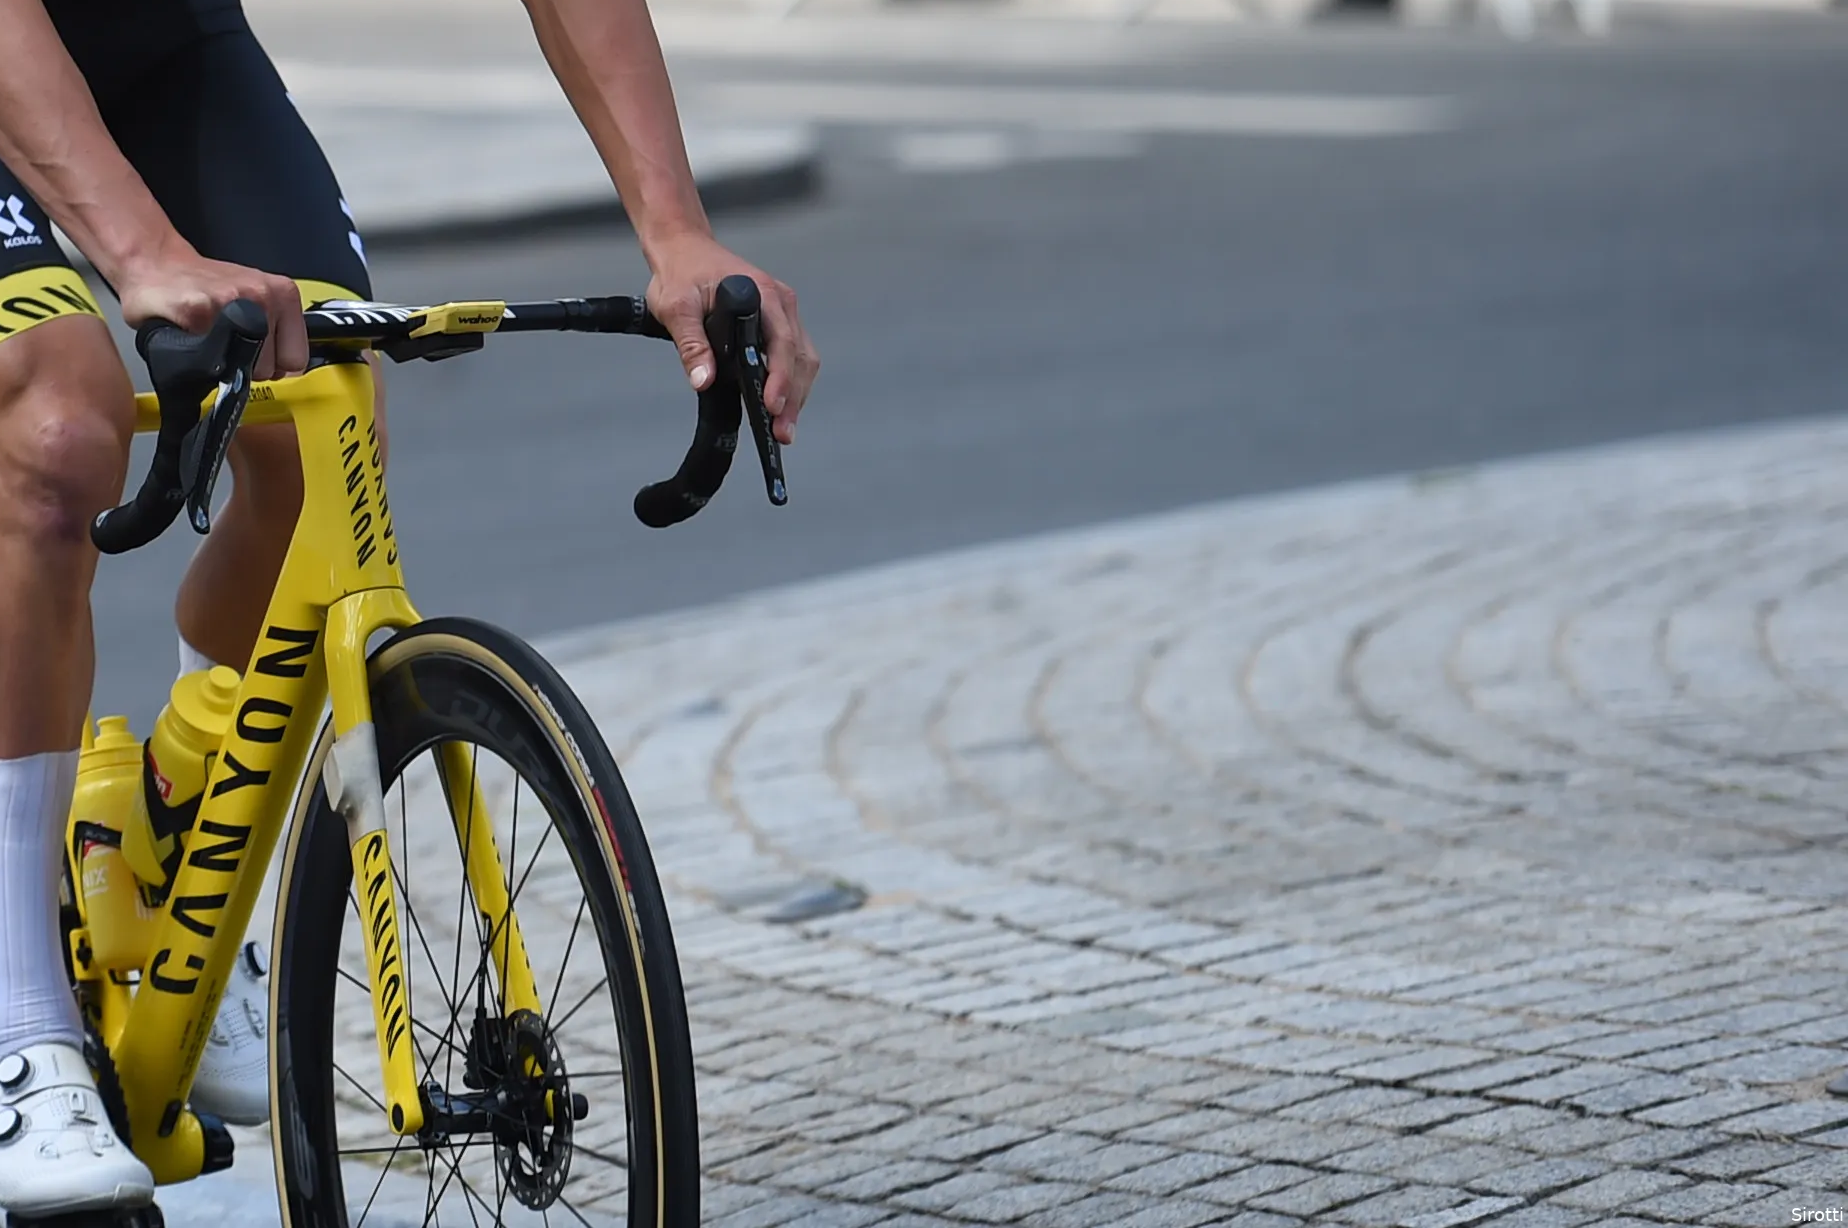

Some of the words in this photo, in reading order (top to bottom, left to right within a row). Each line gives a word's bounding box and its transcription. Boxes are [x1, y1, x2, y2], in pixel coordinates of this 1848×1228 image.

[458, 313, 499, 325] wahoo
[338, 414, 377, 570] CANYON
[150, 624, 320, 995] CANYON
[362, 833, 406, 1062] CANYON
